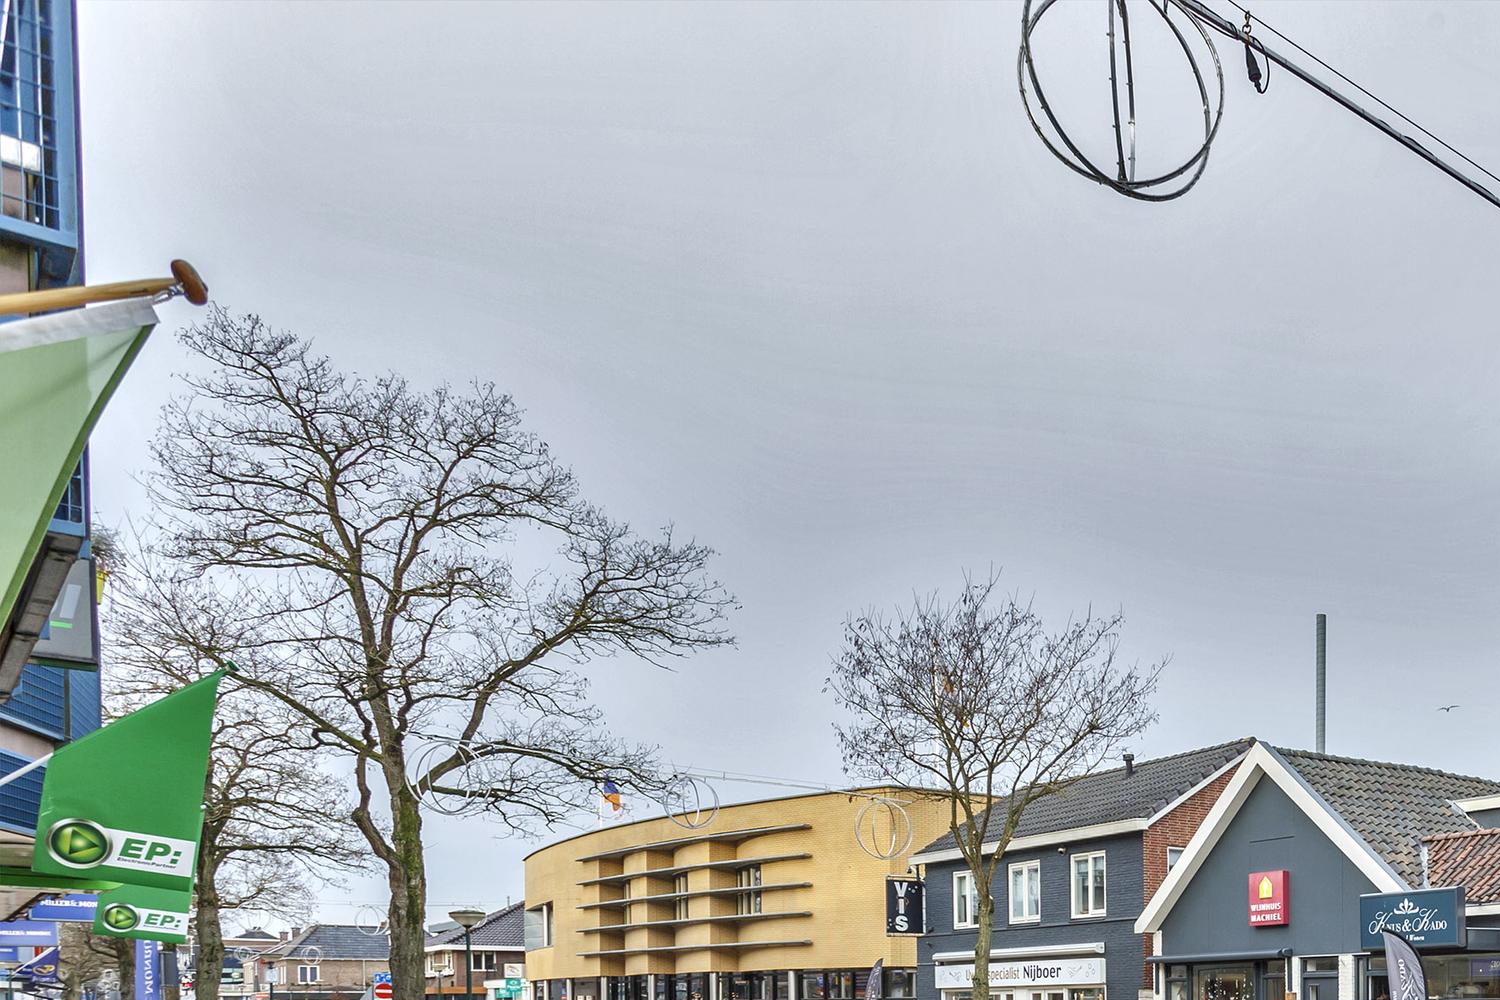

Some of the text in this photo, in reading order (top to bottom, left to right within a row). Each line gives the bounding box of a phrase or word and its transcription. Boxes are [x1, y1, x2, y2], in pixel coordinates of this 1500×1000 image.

[119, 838, 182, 864] EP:
[894, 881, 909, 931] VIS
[1250, 902, 1281, 912] WIJNHUIS
[144, 913, 182, 928] EP:
[1250, 913, 1281, 922] MACHIEL
[1023, 965, 1062, 982] Nijboer
